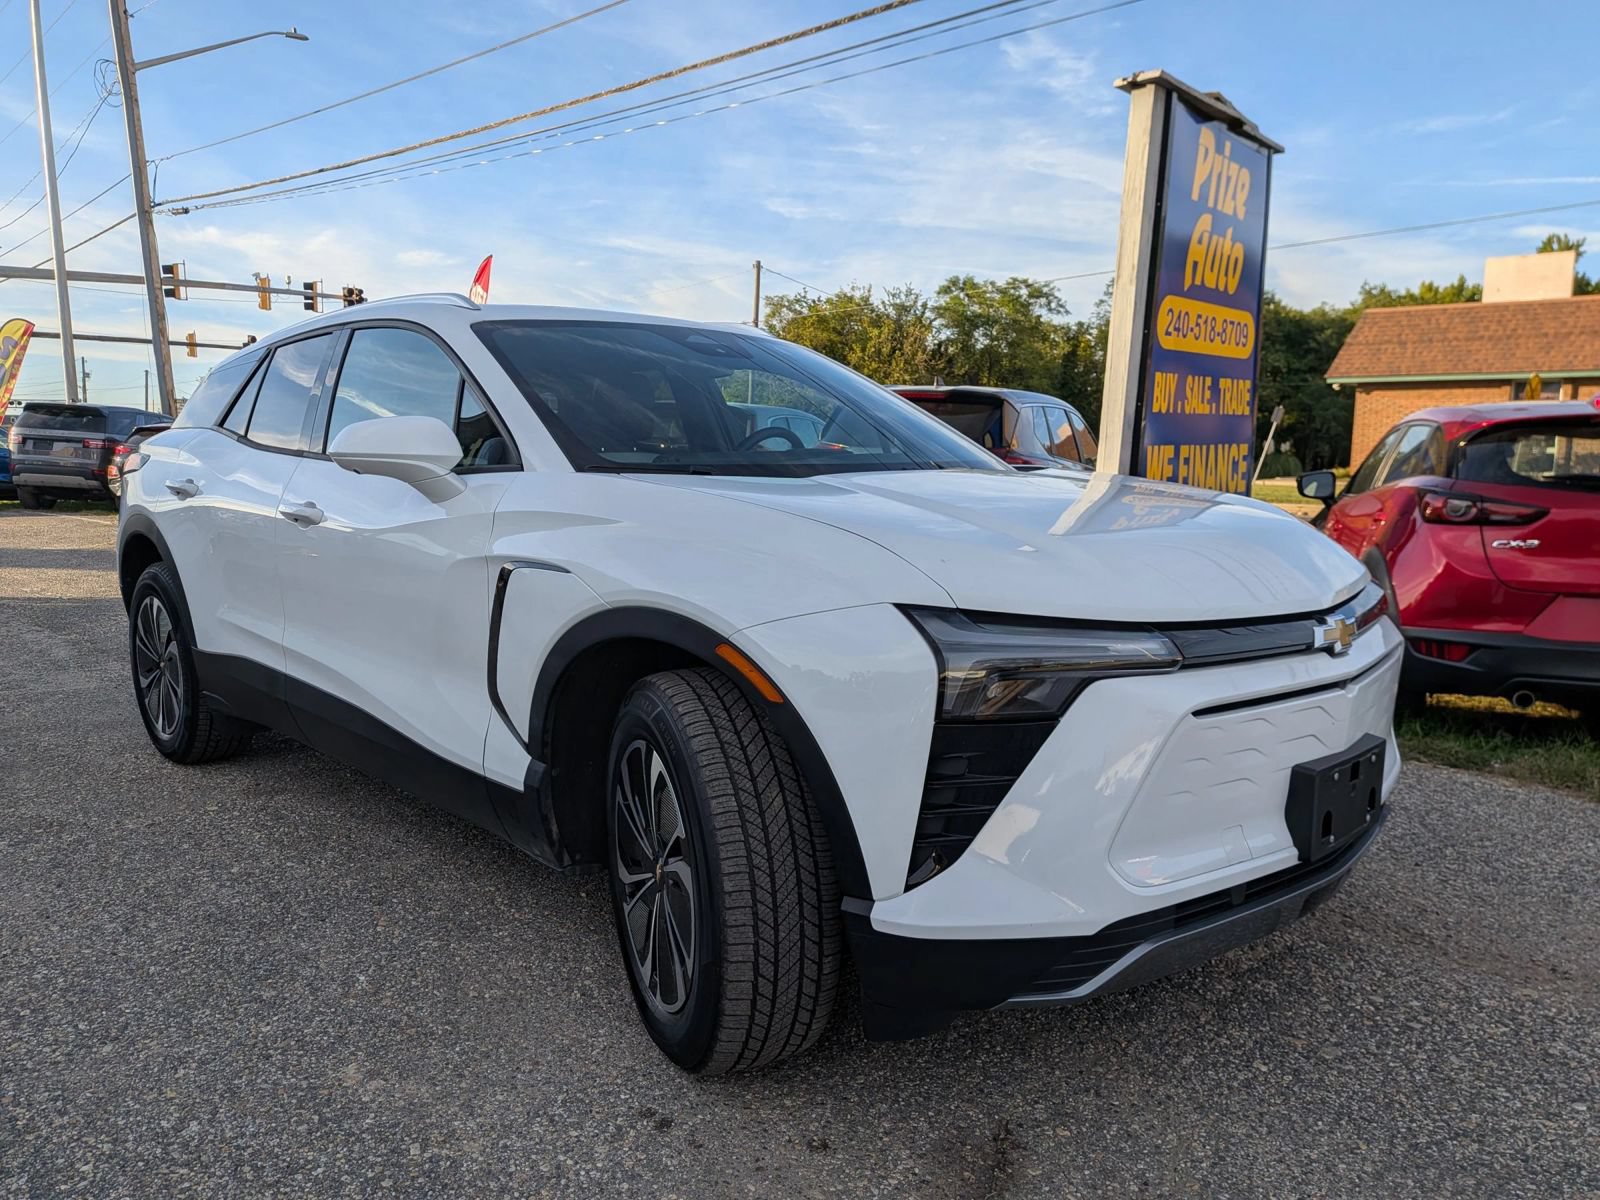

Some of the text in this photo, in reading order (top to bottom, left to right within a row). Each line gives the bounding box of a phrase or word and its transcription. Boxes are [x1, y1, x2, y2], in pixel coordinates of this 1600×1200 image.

[1191, 126, 1251, 221] Prize
[1184, 213, 1244, 295] Auto
[1164, 306, 1249, 349] 240-518-8709
[1218, 377, 1252, 416] TRADE
[1146, 443, 1249, 493] WE FINANCE
